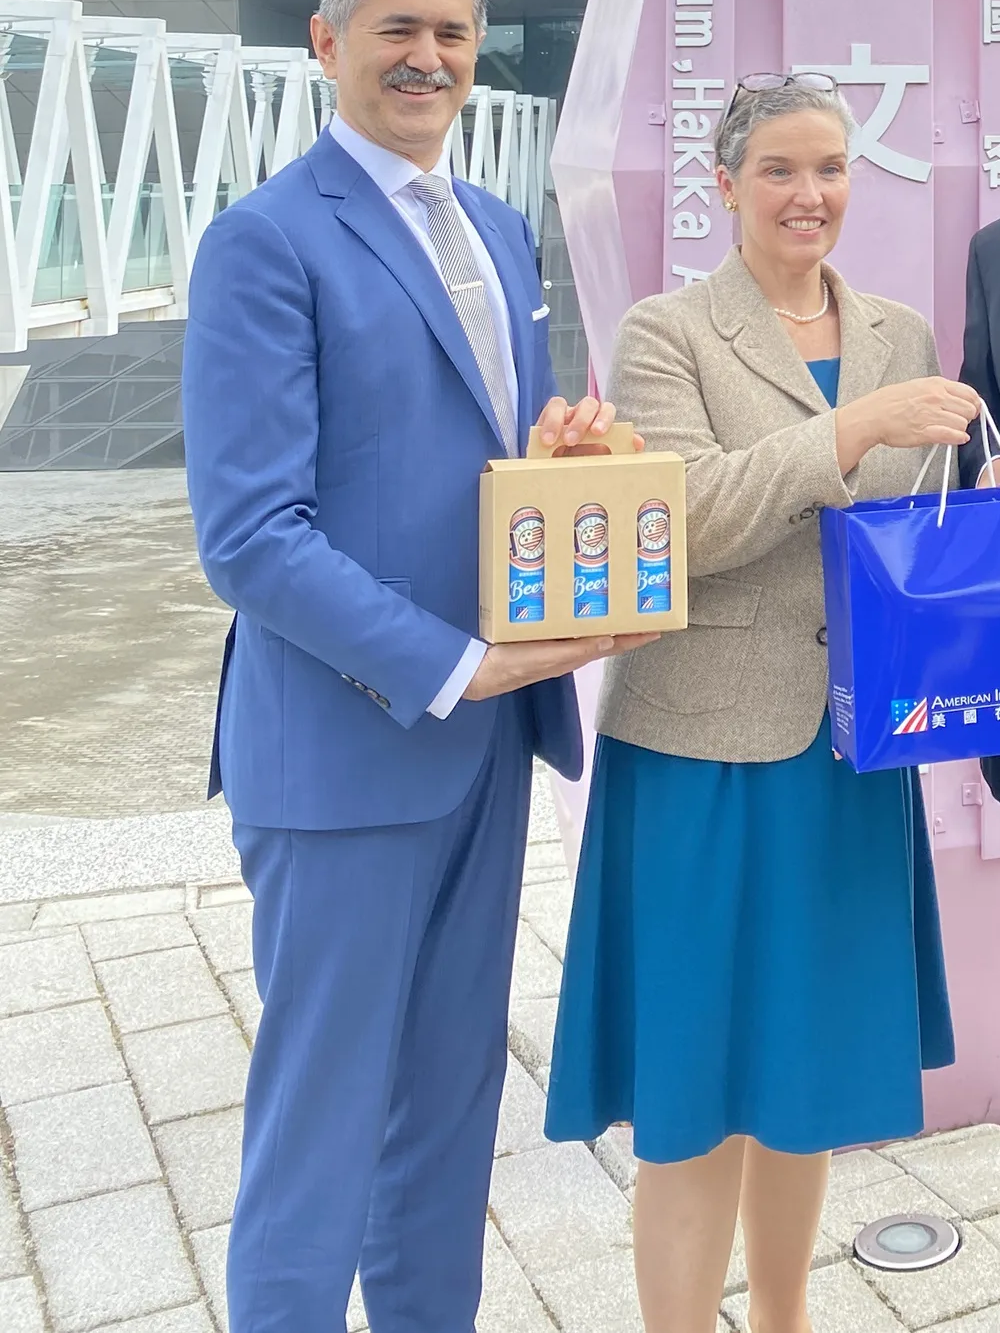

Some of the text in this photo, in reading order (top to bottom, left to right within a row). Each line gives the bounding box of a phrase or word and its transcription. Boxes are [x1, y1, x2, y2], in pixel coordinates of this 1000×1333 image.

[574, 575, 608, 598] Beer
[637, 570, 671, 593] Beer
[931, 693, 991, 710] AMERICAN
